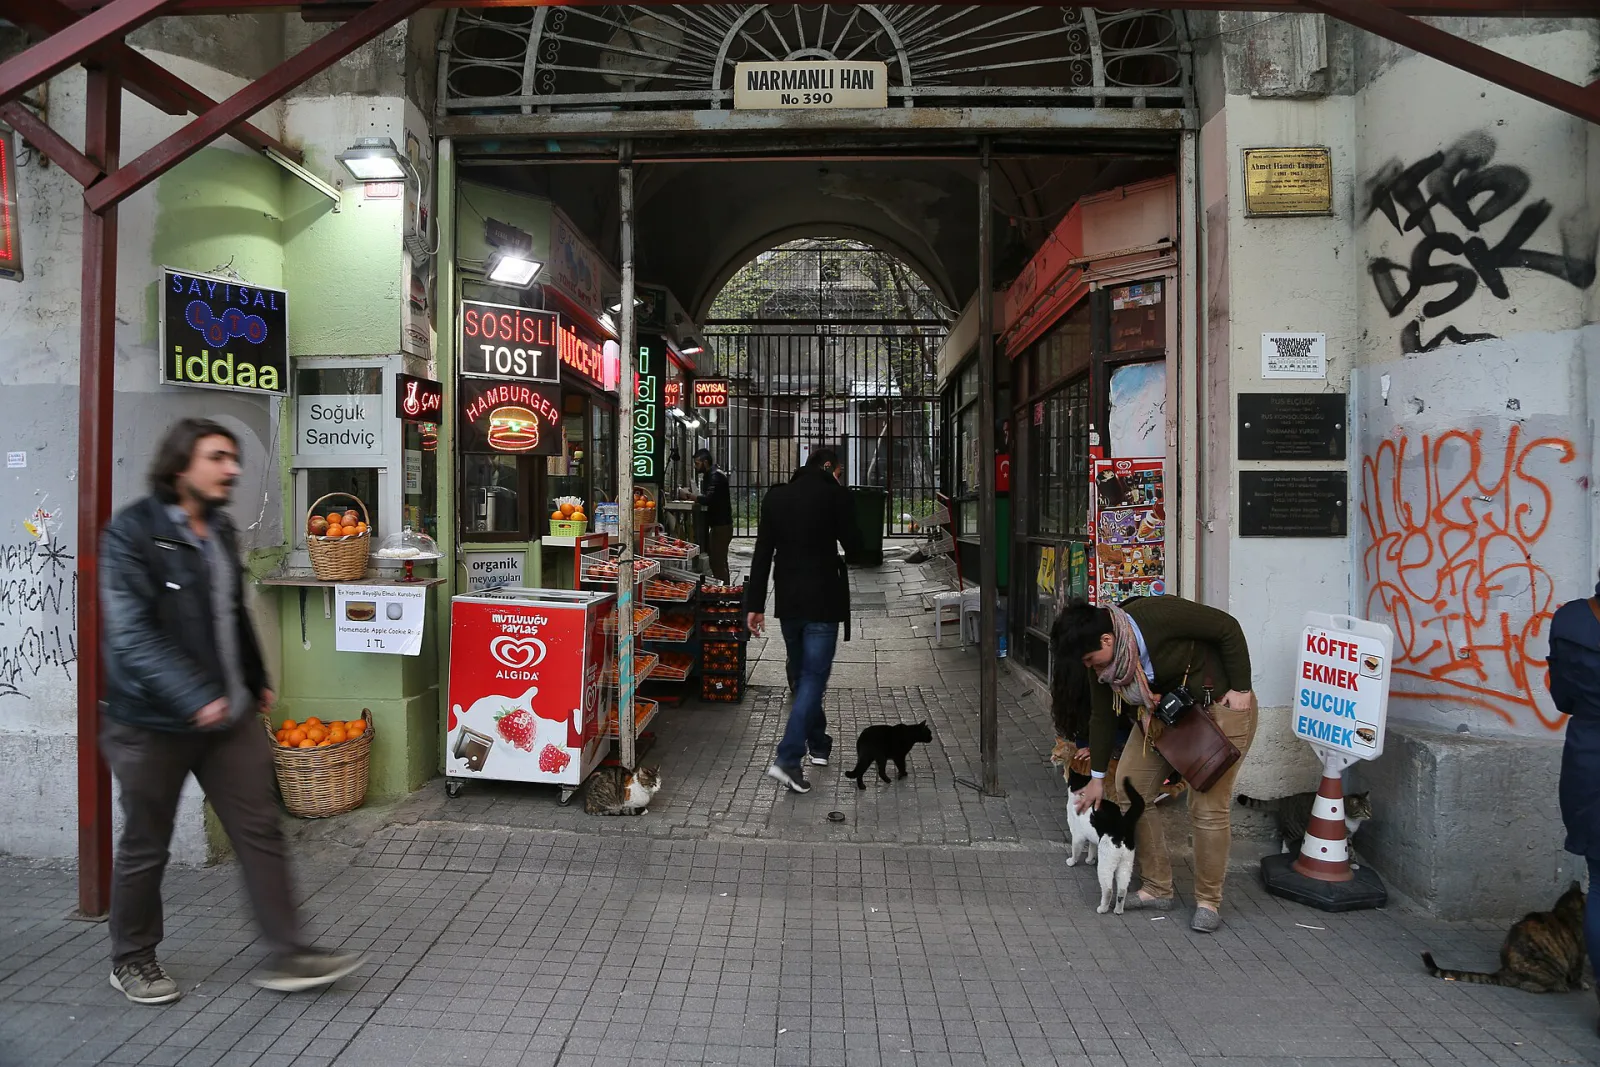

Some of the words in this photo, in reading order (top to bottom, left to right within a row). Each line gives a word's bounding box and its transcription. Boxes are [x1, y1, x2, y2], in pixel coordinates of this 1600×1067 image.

[747, 69, 834, 91] NARMANLI
[840, 69, 874, 90] HAN
[781, 93, 799, 105] No
[803, 92, 833, 105] 390
[173, 274, 279, 311] SAYISAL
[194, 305, 262, 340] LOTO
[465, 309, 557, 347] SOSİSLİ
[174, 345, 279, 390] iddaa
[480, 344, 543, 377] TOST
[696, 383, 727, 393] SAYISAL
[698, 395, 725, 405] LOTO
[310, 404, 365, 424] Soğuk
[421, 392, 441, 411] ÇAY
[466, 385, 559, 427] HAMBURGER
[634, 346, 656, 477] iddaa
[306, 429, 375, 449] Sandviç
[472, 557, 518, 573] organik
[469, 575, 497, 585] meyva
[366, 638, 371, 648] 1
[374, 638, 386, 649] TL
[371, 627, 387, 635] Apple
[1306, 632, 1359, 663] KÖFTE
[1302, 661, 1359, 692] EKMEK
[1300, 688, 1357, 720] SUCUK
[1297, 715, 1354, 748] EKMEK
